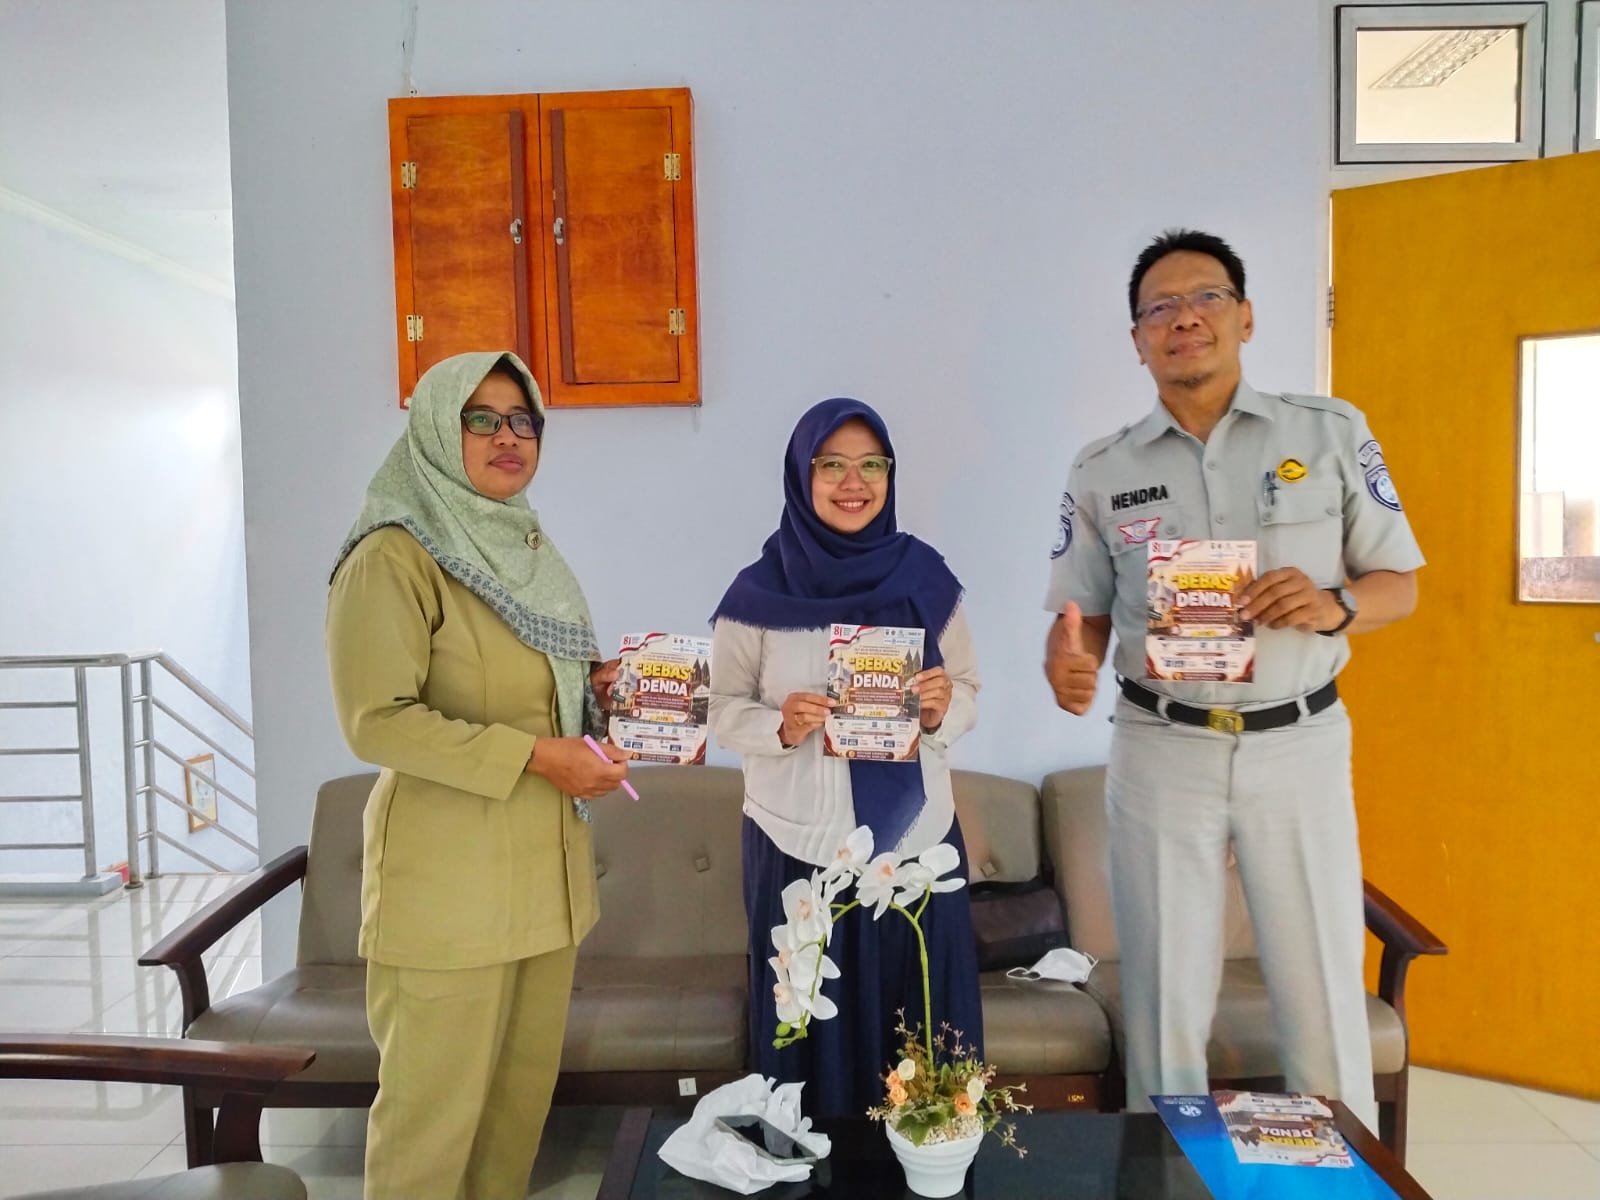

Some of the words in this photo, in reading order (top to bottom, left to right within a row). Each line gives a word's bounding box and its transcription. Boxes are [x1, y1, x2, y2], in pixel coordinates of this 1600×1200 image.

[1111, 485, 1169, 511] HENDRA
[1175, 591, 1232, 608] DENDA
[640, 679, 688, 696] DENDA
[853, 673, 900, 689] DENDA
[1258, 1126, 1314, 1138] DENDA
